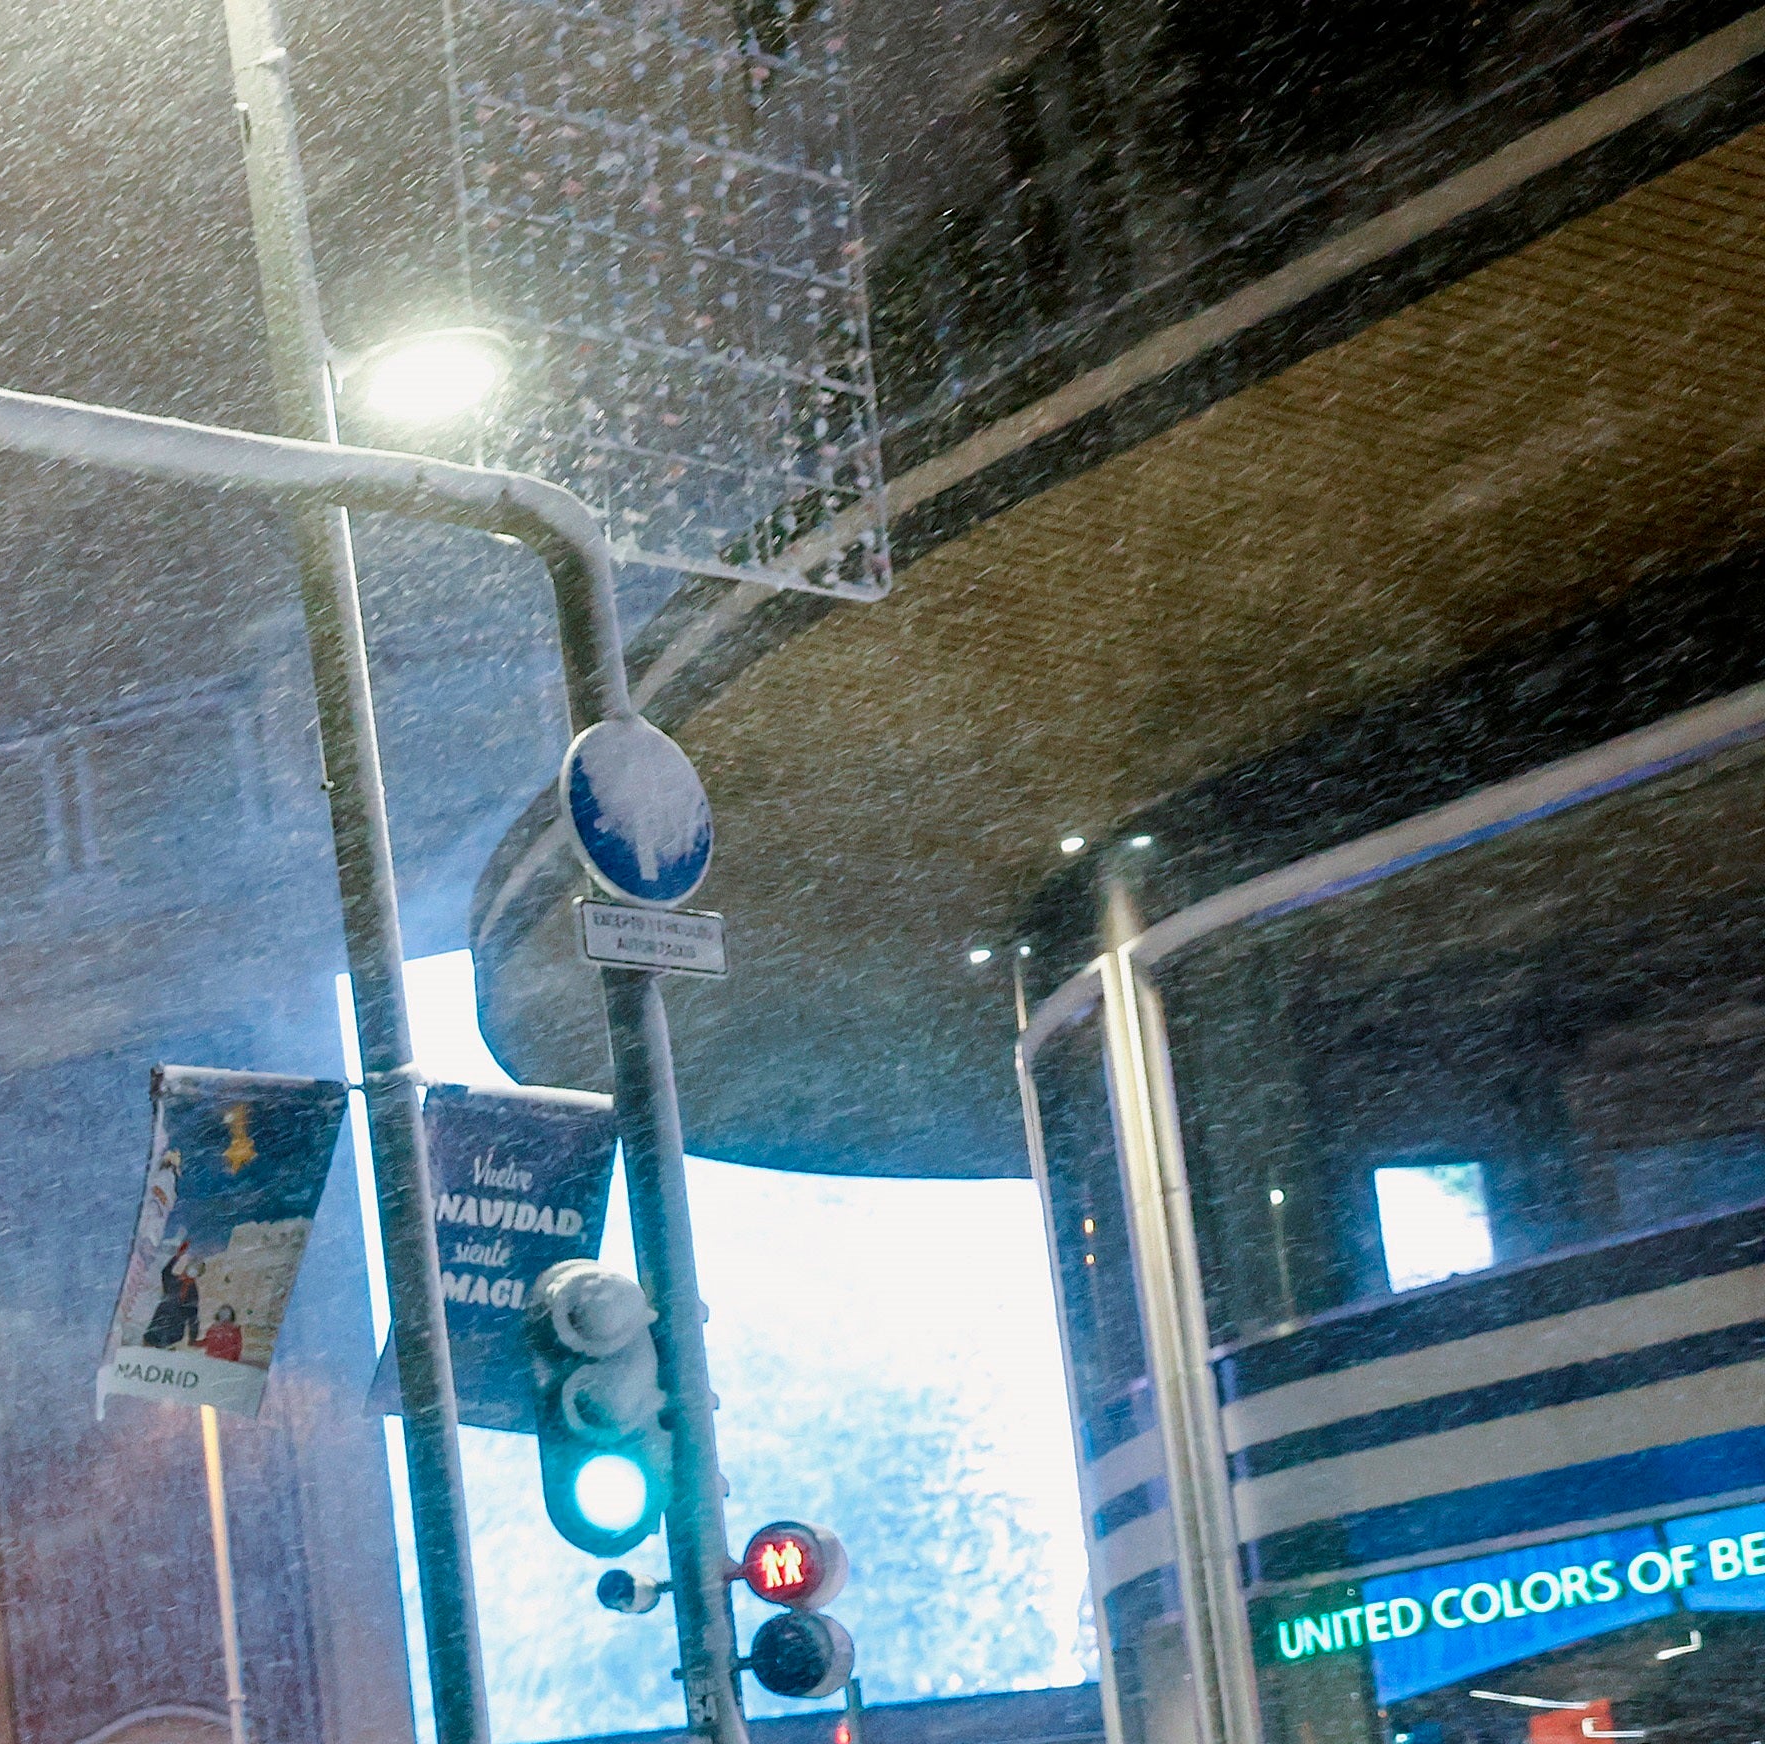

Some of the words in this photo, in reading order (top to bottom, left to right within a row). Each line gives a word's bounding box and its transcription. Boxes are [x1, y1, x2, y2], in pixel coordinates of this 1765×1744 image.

[473, 1154, 534, 1192] Vuelve
[451, 1237, 511, 1267] siente
[115, 1363, 200, 1389] MADRID
[1279, 1597, 1424, 1660] UNITED
[1431, 1559, 1622, 1630] COLORS
[1627, 1544, 1699, 1594] OF
